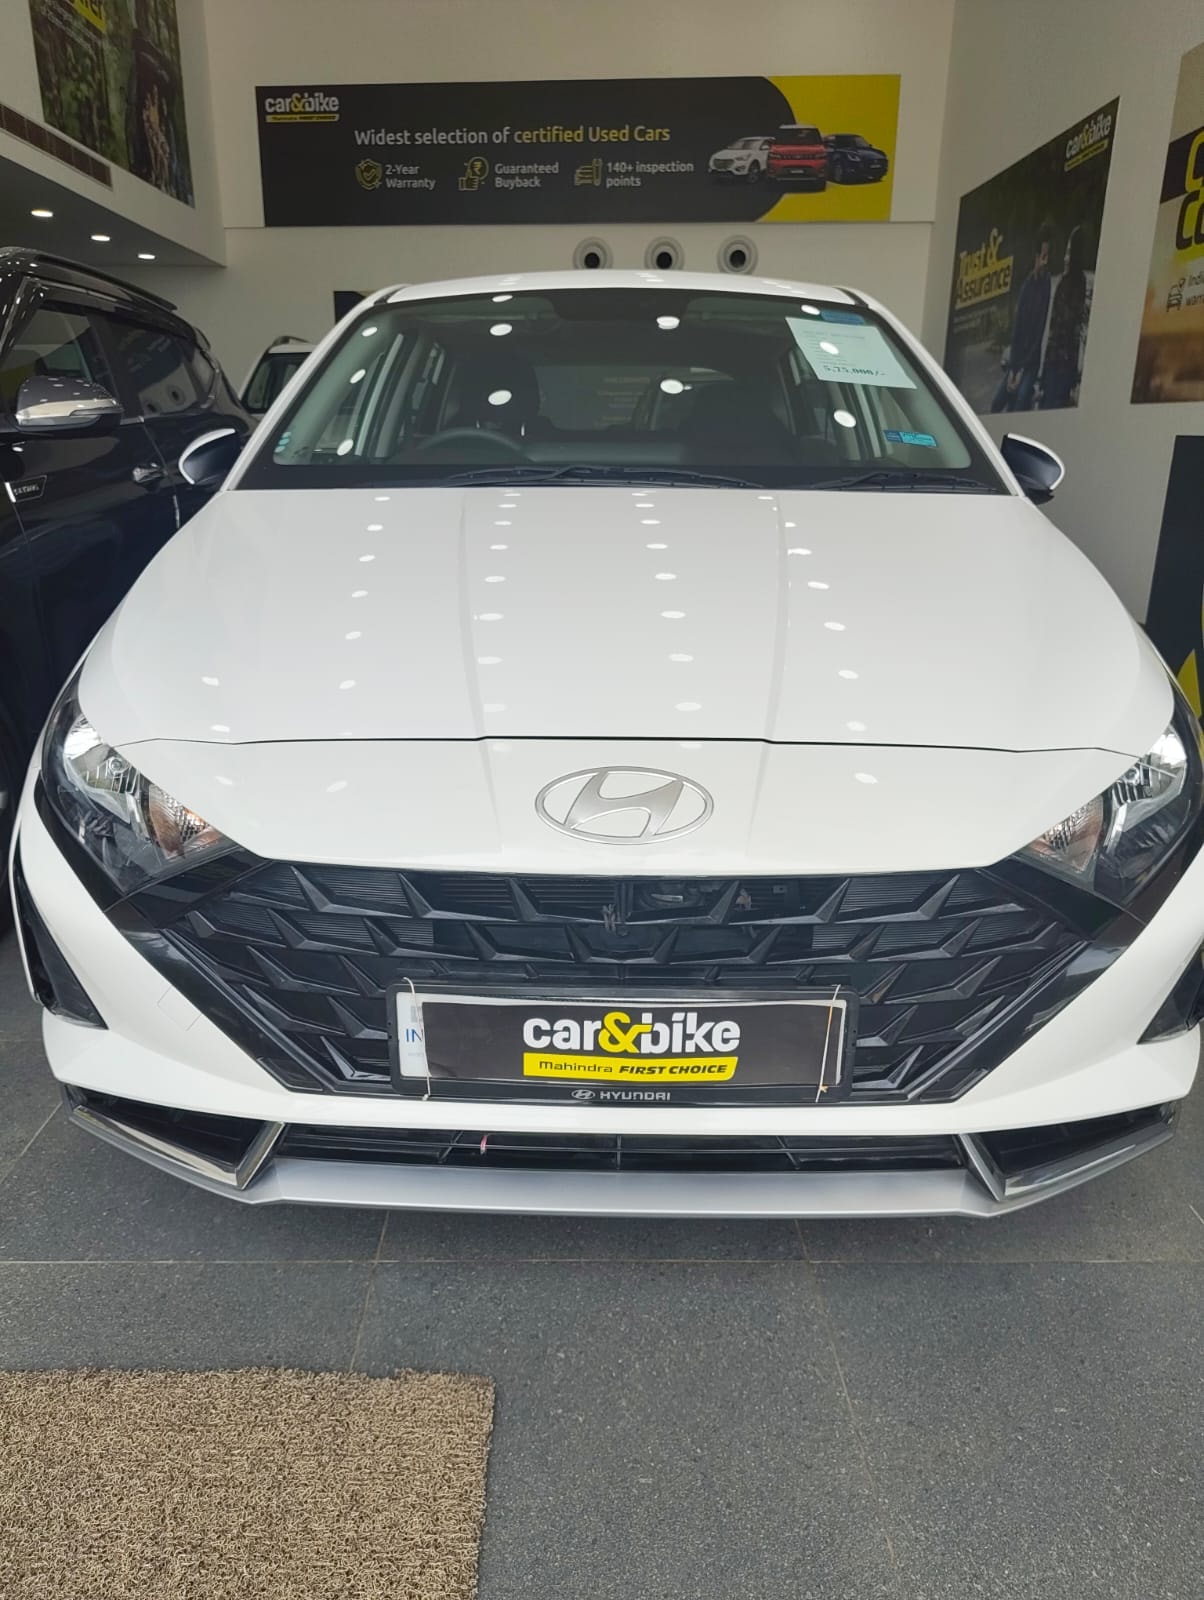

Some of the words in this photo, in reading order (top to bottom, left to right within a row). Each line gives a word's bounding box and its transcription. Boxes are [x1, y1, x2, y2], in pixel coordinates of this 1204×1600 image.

[265, 92, 339, 112] car&bike
[354, 129, 411, 145] Widest
[414, 128, 488, 145] selection
[492, 126, 510, 143] of
[513, 125, 584, 143] certified
[588, 125, 629, 142] Used
[633, 125, 671, 142] Cars
[385, 164, 419, 175] 2-Year
[495, 162, 559, 174] Guaranteed
[606, 162, 633, 173] 140+
[635, 161, 694, 174] inspection
[385, 178, 436, 190] Warranty
[495, 177, 541, 190] Buyback
[606, 175, 641, 188] points
[959, 242, 985, 280] Trust
[987, 227, 1003, 267] &
[956, 264, 1011, 304] Assurance
[523, 1011, 741, 1054] car&bike
[539, 1060, 613, 1073] Mahindra
[619, 1065, 666, 1075] FIRST
[669, 1064, 728, 1075] CHOICE
[600, 1091, 671, 1101] HYUNDAI
